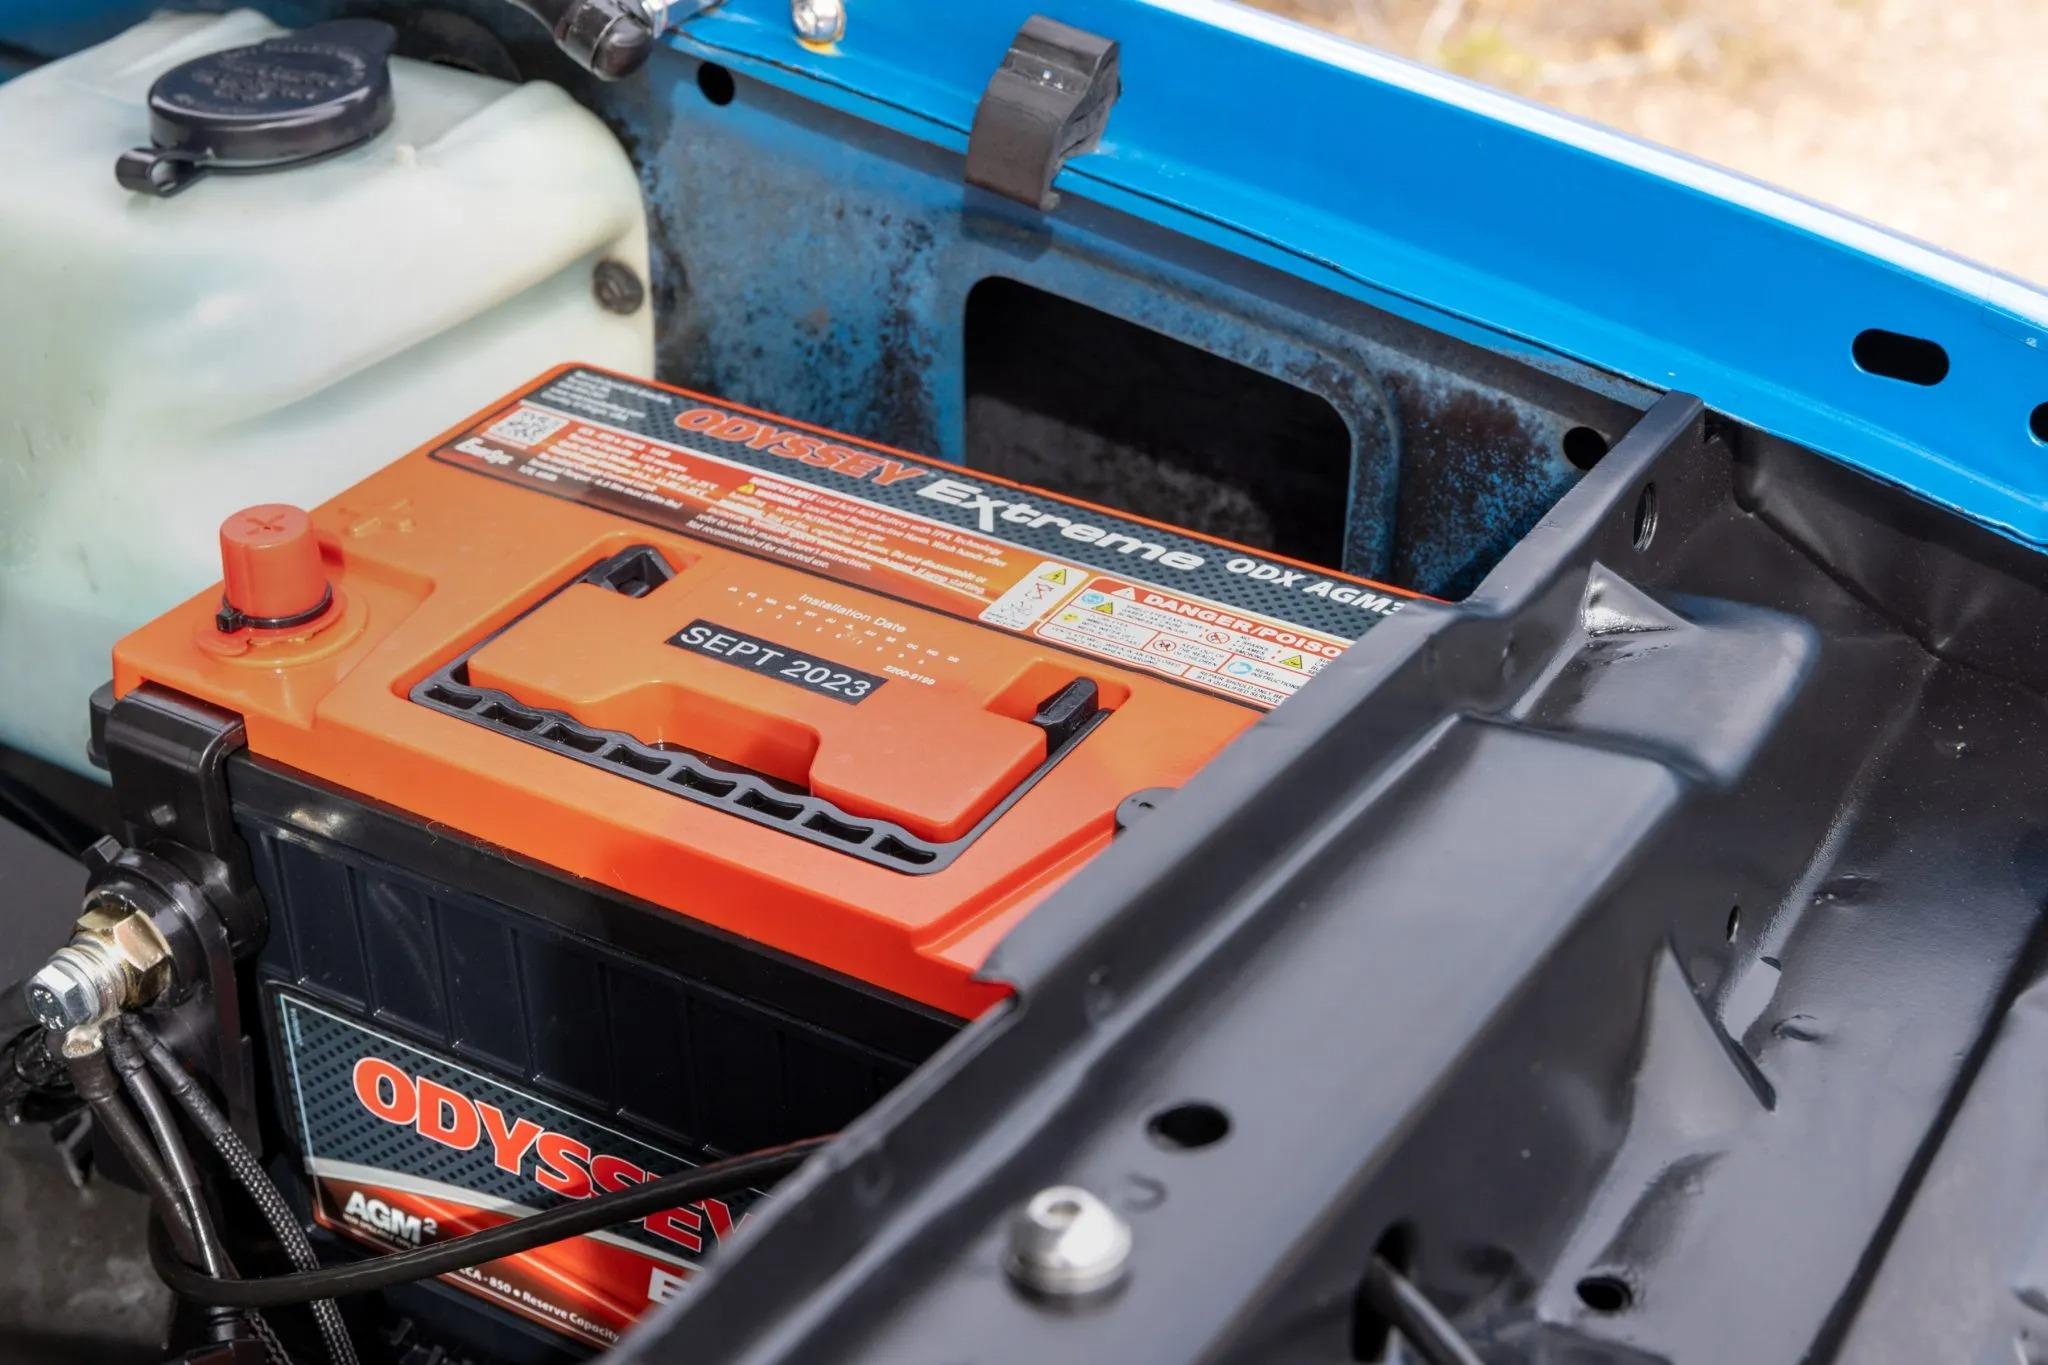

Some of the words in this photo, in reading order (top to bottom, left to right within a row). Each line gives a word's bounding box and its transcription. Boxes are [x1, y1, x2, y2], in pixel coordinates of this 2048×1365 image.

[674, 408, 925, 486] ODYSSEY
[916, 478, 1205, 571] Extreme
[1225, 558, 1307, 588] ODX
[687, 519, 703, 529] Not
[702, 524, 763, 547] recommended
[762, 543, 777, 552] for
[776, 547, 812, 562] inverted
[715, 518, 728, 527] to
[726, 522, 757, 535] vehicle
[878, 514, 911, 528] Battery
[910, 523, 932, 534] with
[953, 535, 1003, 555] Technology
[798, 593, 872, 622] Installation
[873, 617, 907, 633] Date
[1143, 595, 1344, 659] DANGER/POISO
[680, 626, 784, 667] SEPT
[780, 659, 872, 698] 2023
[489, 1276, 512, 1294] 850
[522, 1291, 568, 1320] Reserve
[569, 1313, 620, 1343] Capacity
